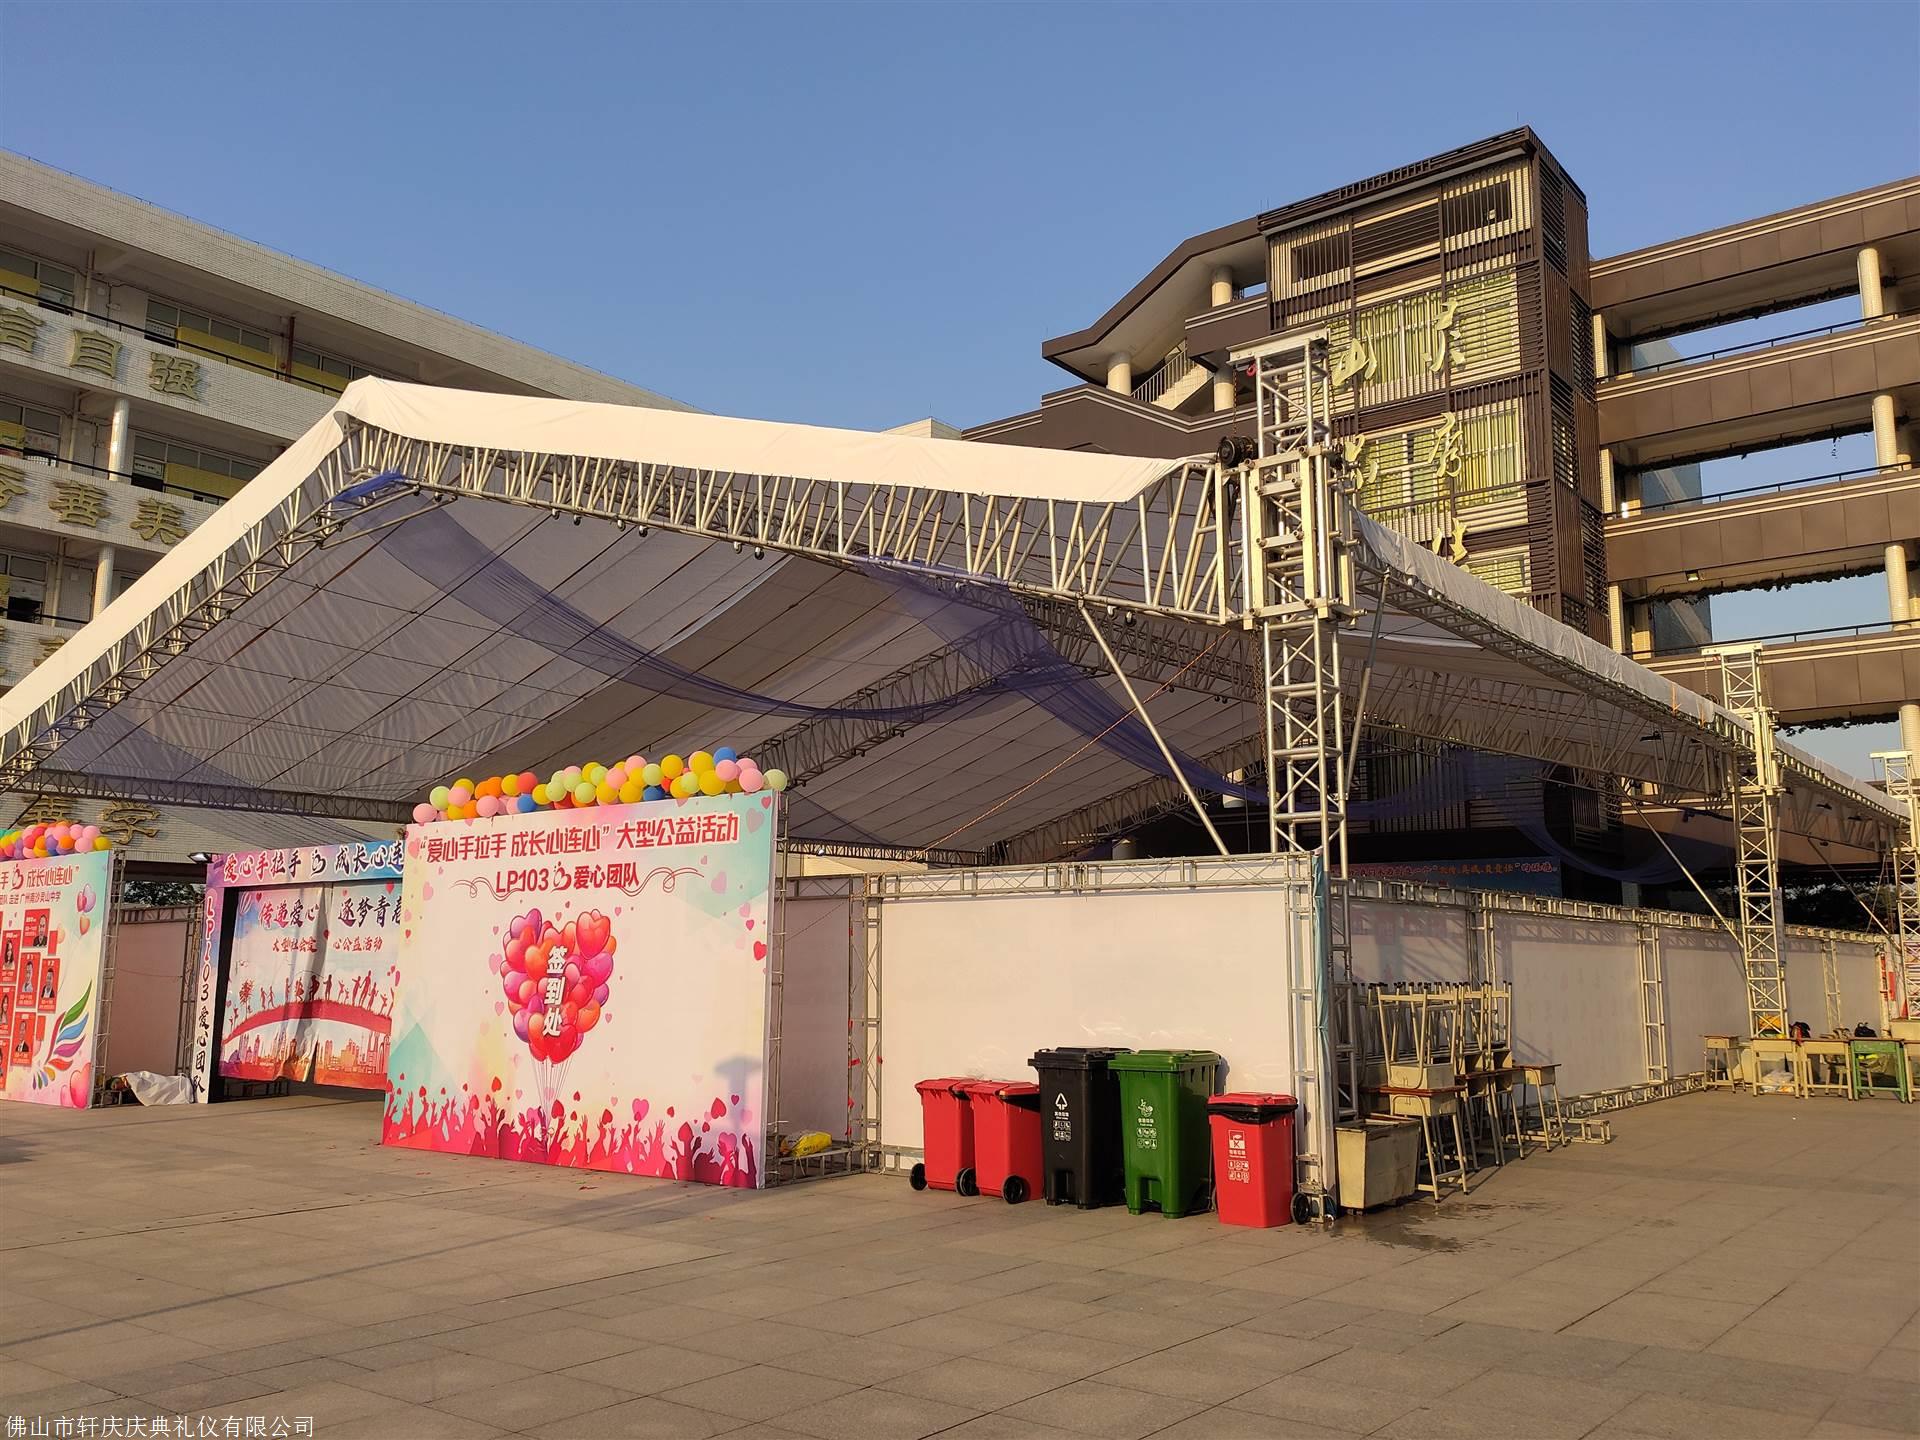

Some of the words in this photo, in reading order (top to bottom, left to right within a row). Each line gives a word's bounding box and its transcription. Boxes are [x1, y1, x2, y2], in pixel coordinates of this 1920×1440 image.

[616, 813, 739, 849] 大型公益活动
[223, 849, 302, 882] 爱心手拉手
[496, 868, 549, 893] LP103
[573, 862, 639, 890] 爱心团队
[260, 898, 320, 930] 传递爱心
[542, 945, 568, 1037] 签到处
